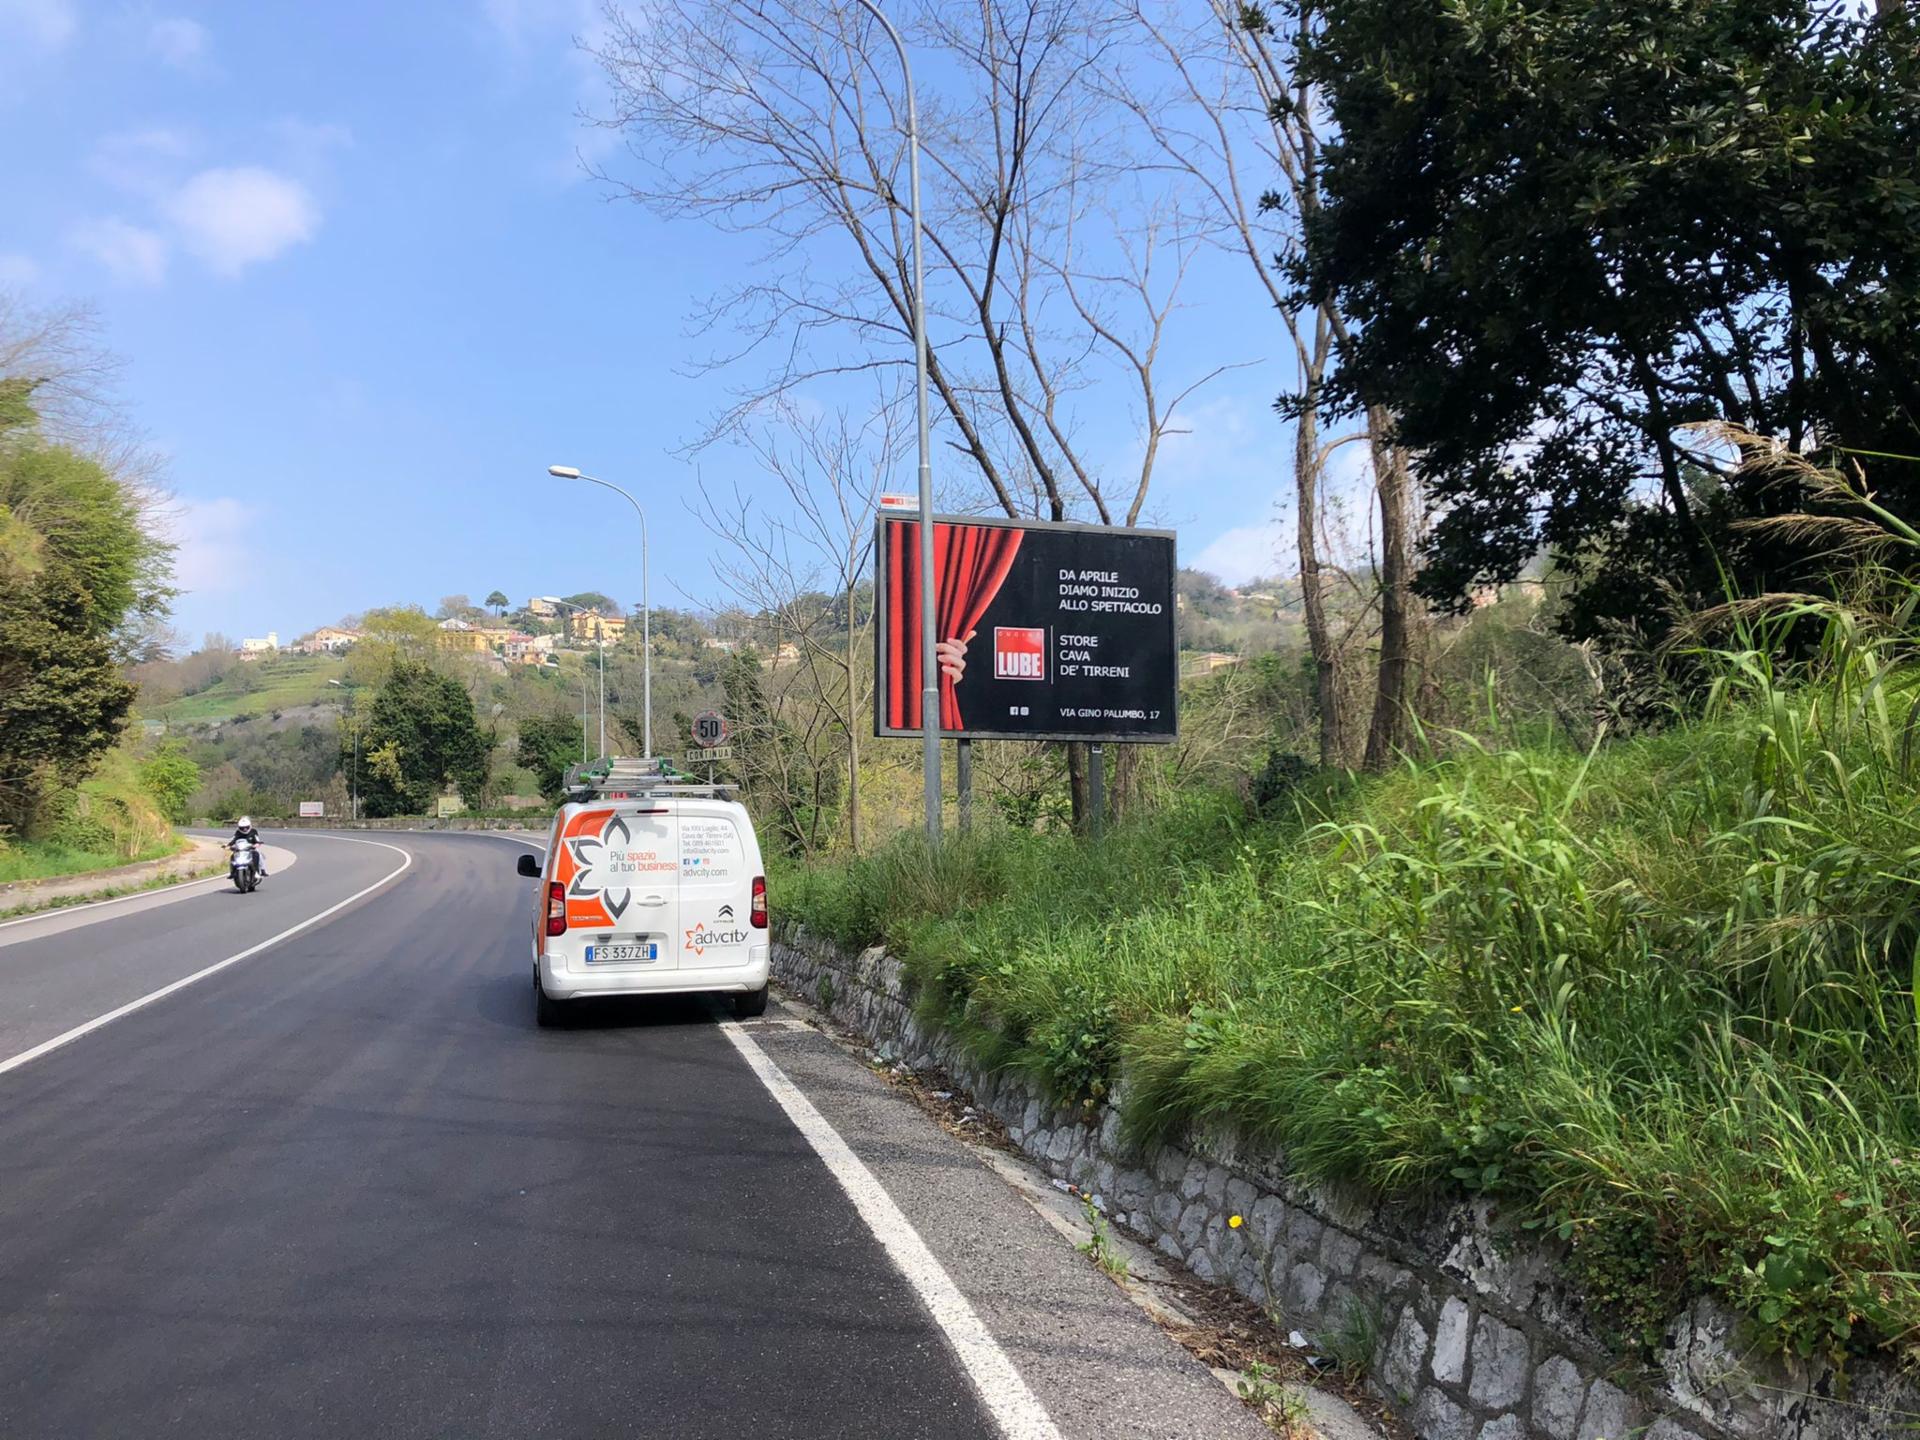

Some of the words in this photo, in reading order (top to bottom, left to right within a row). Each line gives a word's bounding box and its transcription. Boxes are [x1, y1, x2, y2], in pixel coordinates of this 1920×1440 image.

[1059, 569, 1076, 581] DA
[1079, 570, 1119, 583] APRILE
[1059, 584, 1098, 597] DIAMO
[1101, 586, 1139, 599] INIZIO
[1059, 599, 1089, 611] ALLO
[1091, 600, 1162, 615] SPETTACOLO
[1060, 634, 1099, 647] STORE
[1060, 650, 1091, 661] CAVA
[998, 651, 1041, 677] LUBE
[1060, 665, 1079, 676] DE'
[1082, 665, 1130, 678] TIRRENI
[1060, 708, 1076, 717] VIA
[1078, 708, 1102, 718] GINO
[1103, 709, 1147, 720] PALUMBO,
[1149, 710, 1160, 719] 17
[700, 720, 719, 738] 50
[610, 850, 625, 861] Più
[627, 851, 656, 863] spazio
[609, 862, 619, 872] al
[620, 863, 636, 872] tuo
[637, 861, 678, 872] business
[695, 929, 749, 945] advcity
[594, 947, 609, 960] FS
[612, 946, 649, 959] 337ZH
